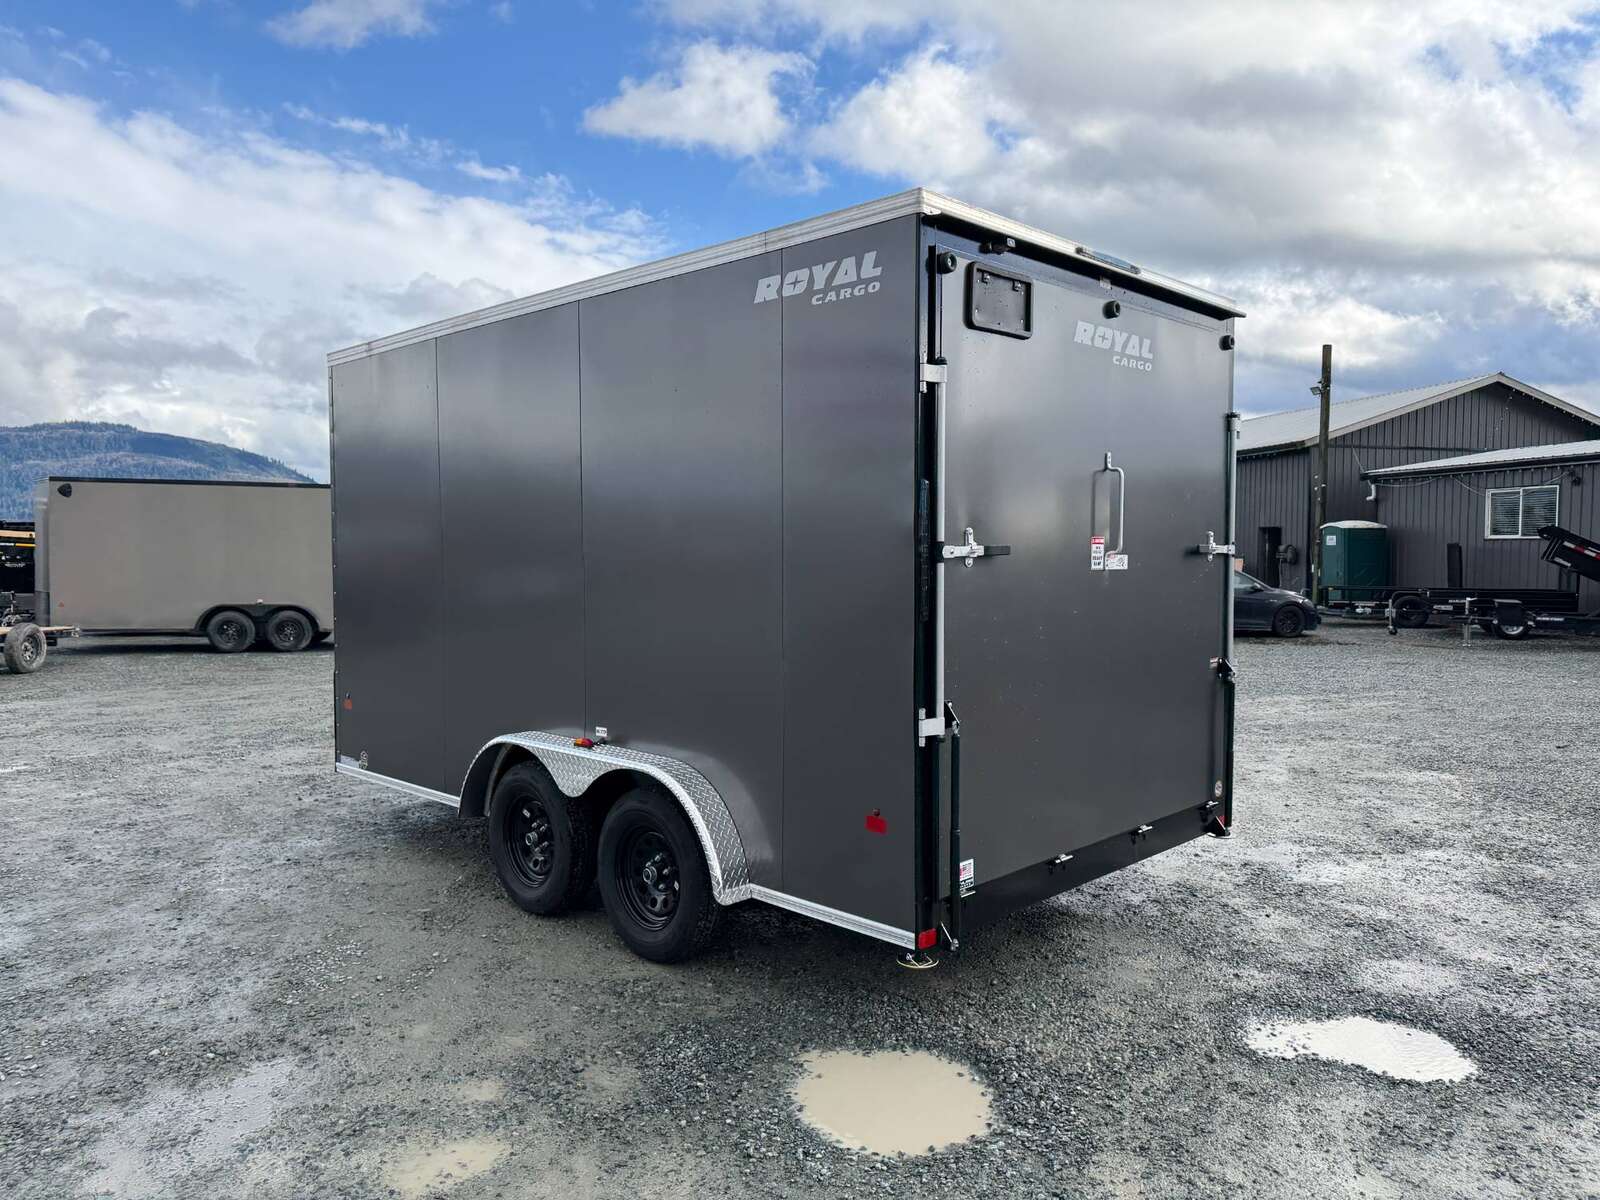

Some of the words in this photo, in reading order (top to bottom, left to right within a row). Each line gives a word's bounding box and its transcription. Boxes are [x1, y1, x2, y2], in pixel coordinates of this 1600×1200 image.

[754, 251, 882, 304] ROYAL
[811, 281, 881, 305] CARGO
[1074, 321, 1153, 360] ROYAL
[1112, 355, 1153, 371] CARGO
